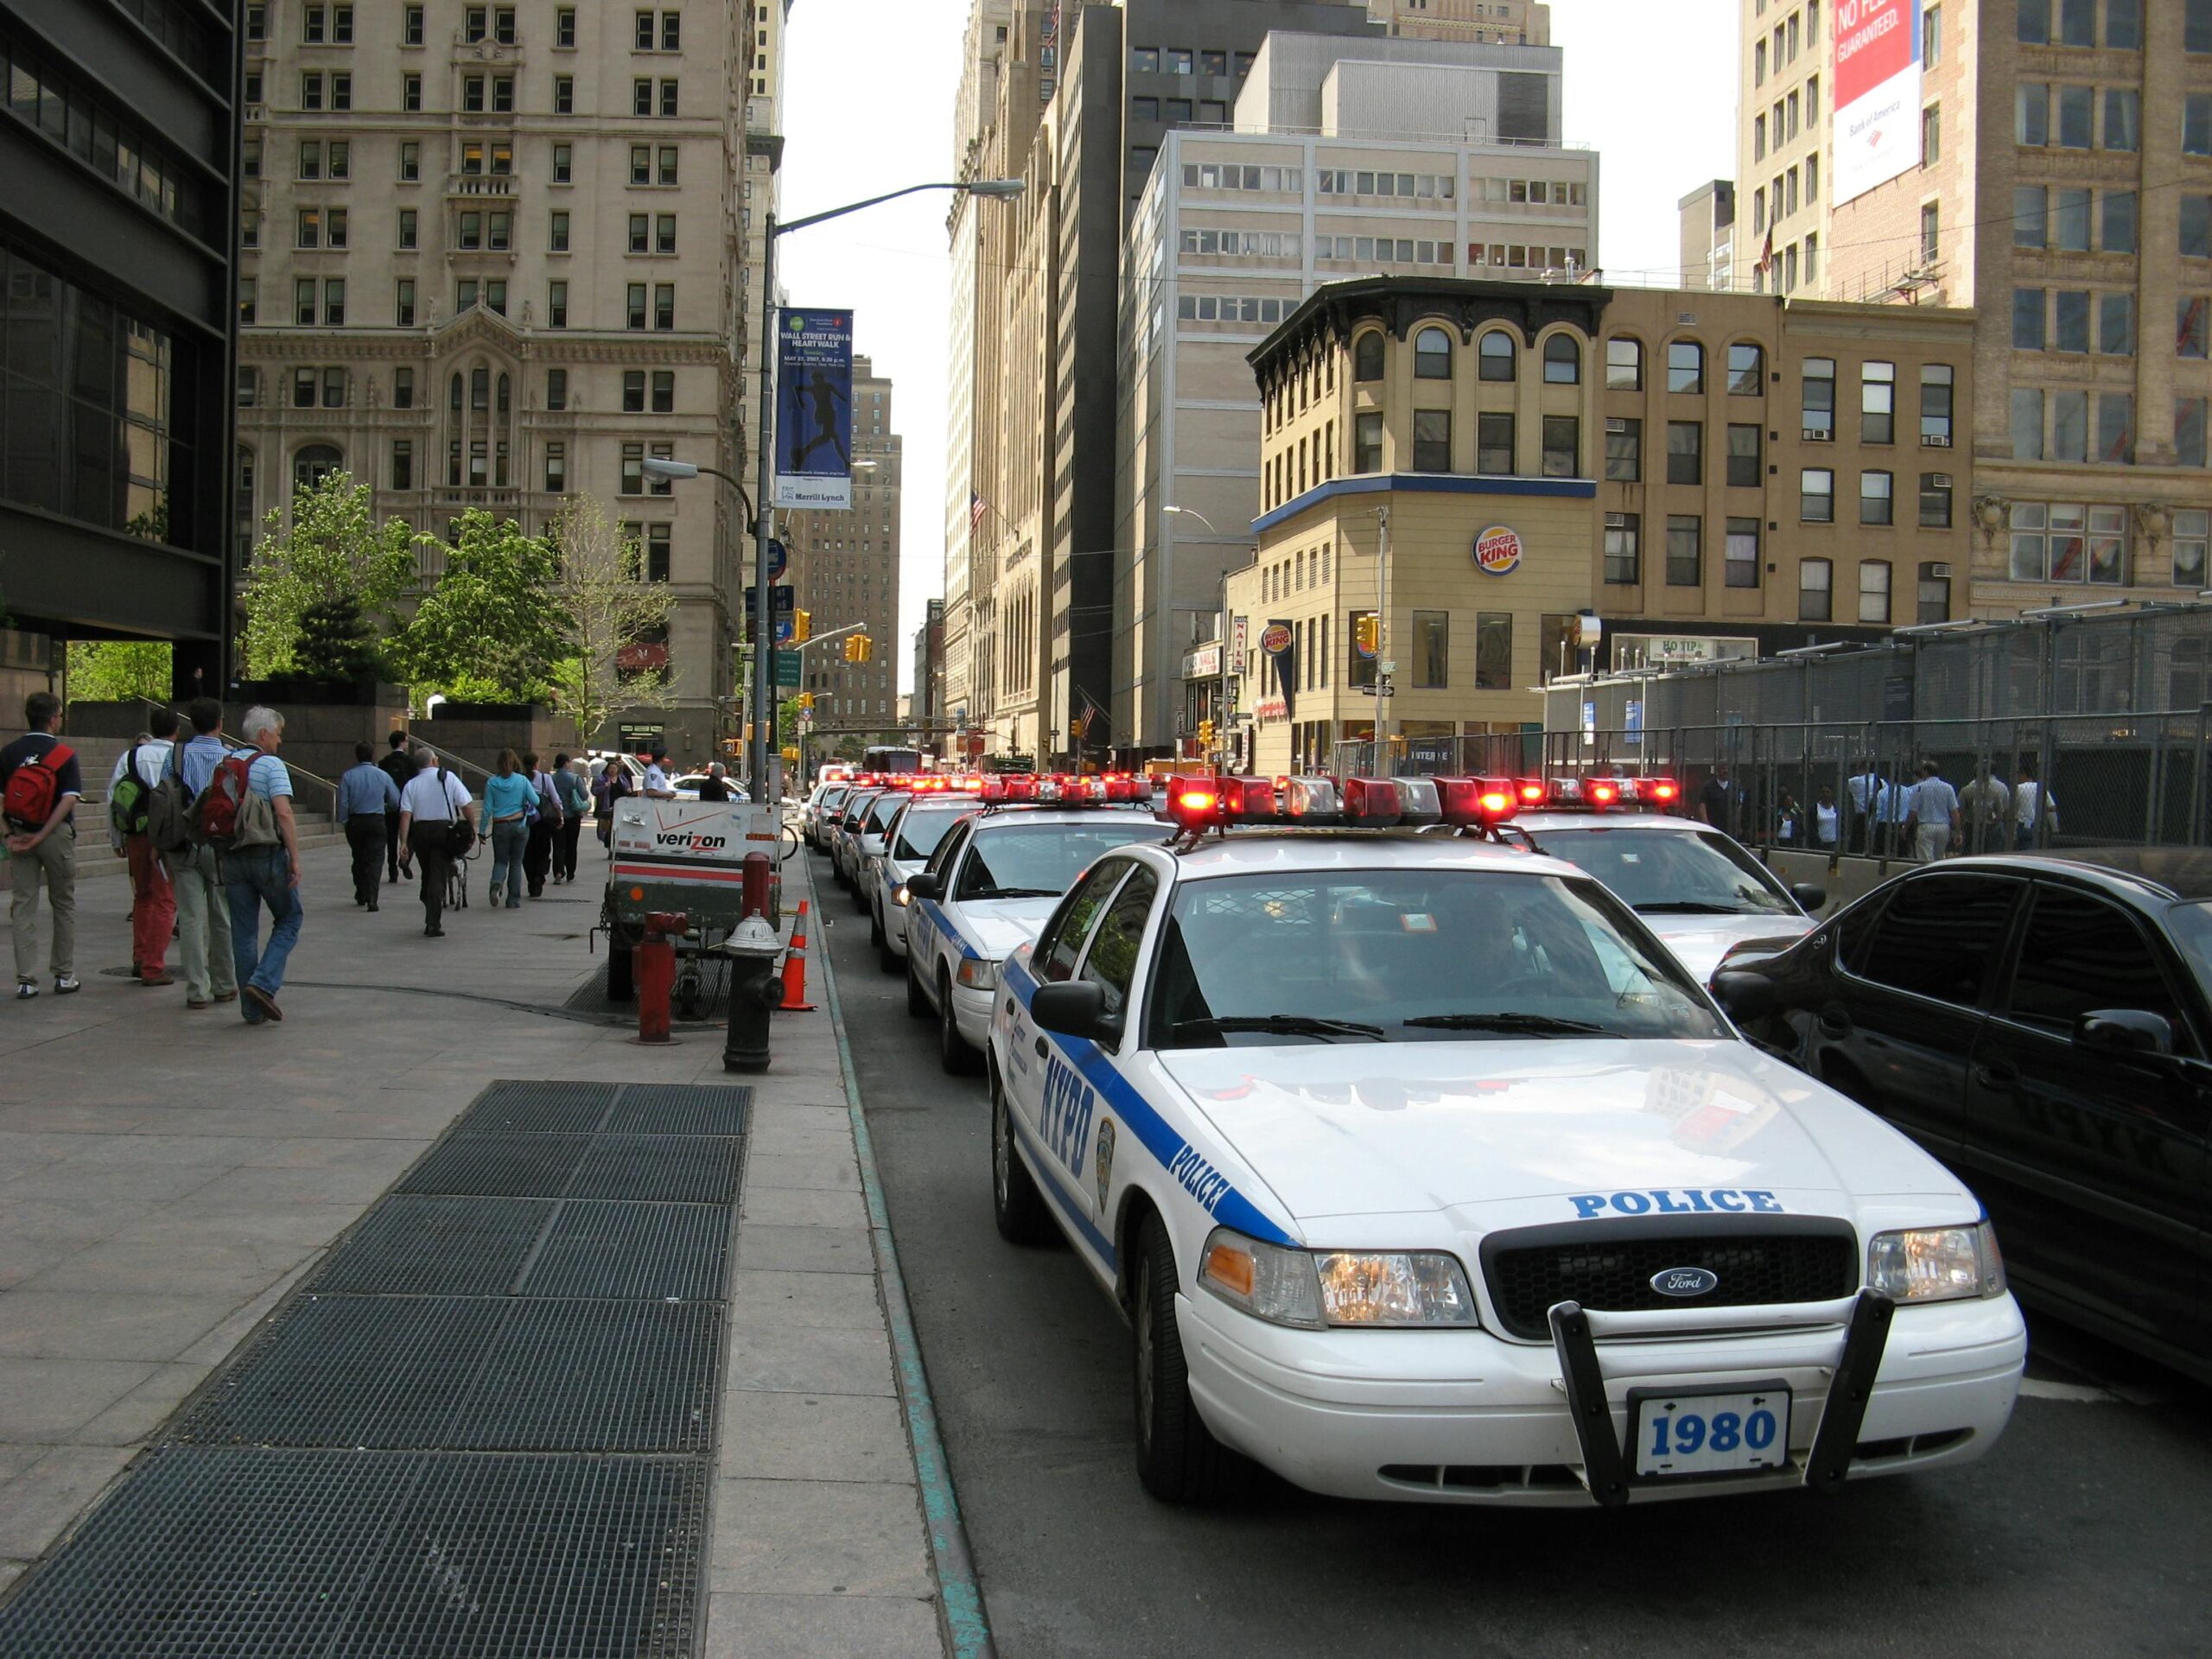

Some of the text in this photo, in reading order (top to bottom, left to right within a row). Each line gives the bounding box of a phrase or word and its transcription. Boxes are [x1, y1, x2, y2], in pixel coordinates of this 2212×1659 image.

[1838, 0, 1857, 35] NO
[1837, 9, 1898, 63] GUARANTEED.
[1850, 100, 1900, 137] Bank of America
[1478, 534, 1516, 553] BURGER
[1480, 543, 1518, 566] KING
[1265, 629, 1288, 640] BURGER
[1266, 636, 1289, 648] KING
[1662, 640, 1677, 651] HO
[657, 831, 726, 851] verizon
[1041, 1053, 1095, 1179] NYPD
[1169, 1144, 1230, 1213] POLICE
[1568, 1189, 1784, 1218] POLICE
[1667, 1273, 1702, 1290] Ford
[1651, 1409, 1777, 1456] 1980
